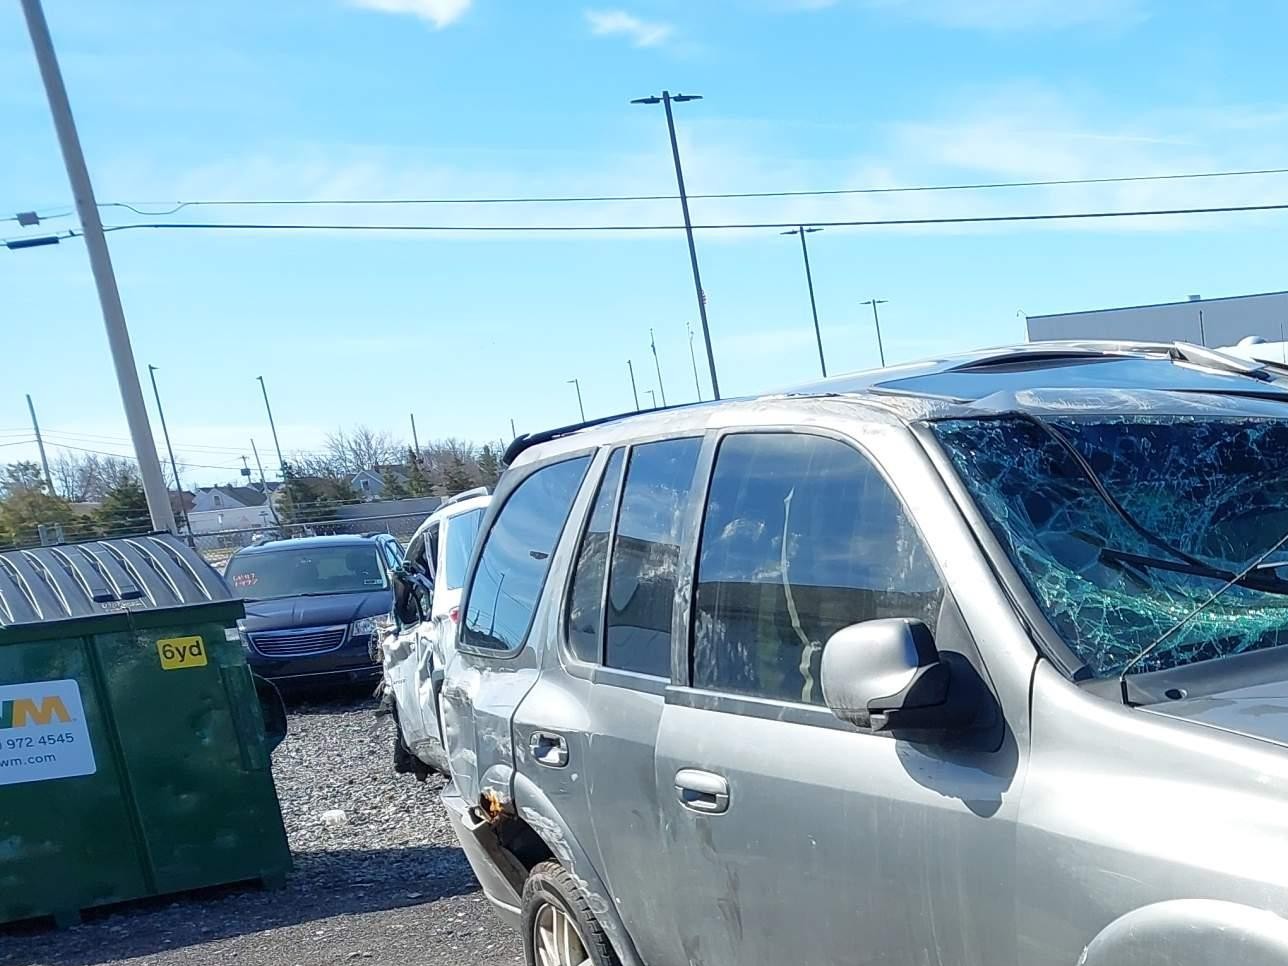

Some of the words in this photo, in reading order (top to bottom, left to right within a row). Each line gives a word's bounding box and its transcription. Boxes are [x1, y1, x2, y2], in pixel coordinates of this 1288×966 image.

[162, 640, 203, 662] 6yd
[7, 737, 34, 749] 972
[38, 733, 74, 746] 4545
[0, 754, 56, 767] wm.com
